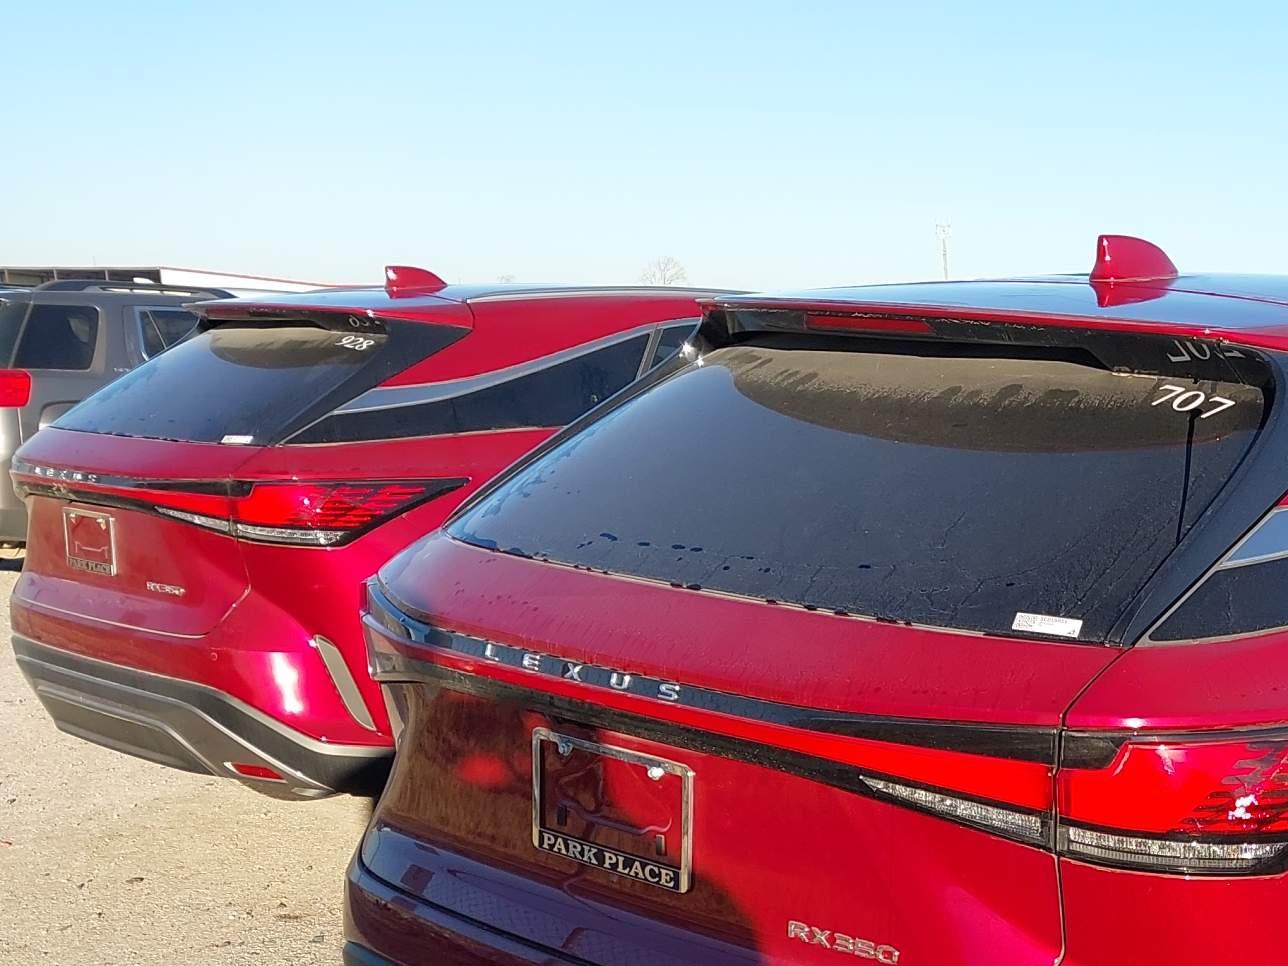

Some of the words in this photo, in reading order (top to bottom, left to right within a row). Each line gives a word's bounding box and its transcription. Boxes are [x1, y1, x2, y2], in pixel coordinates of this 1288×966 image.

[335, 335, 375, 351] 928
[1151, 384, 1236, 419] 707
[484, 643, 681, 701] LEXUS
[542, 832, 599, 865] PARK
[603, 851, 675, 888] PLACE
[787, 920, 900, 966] RX350
